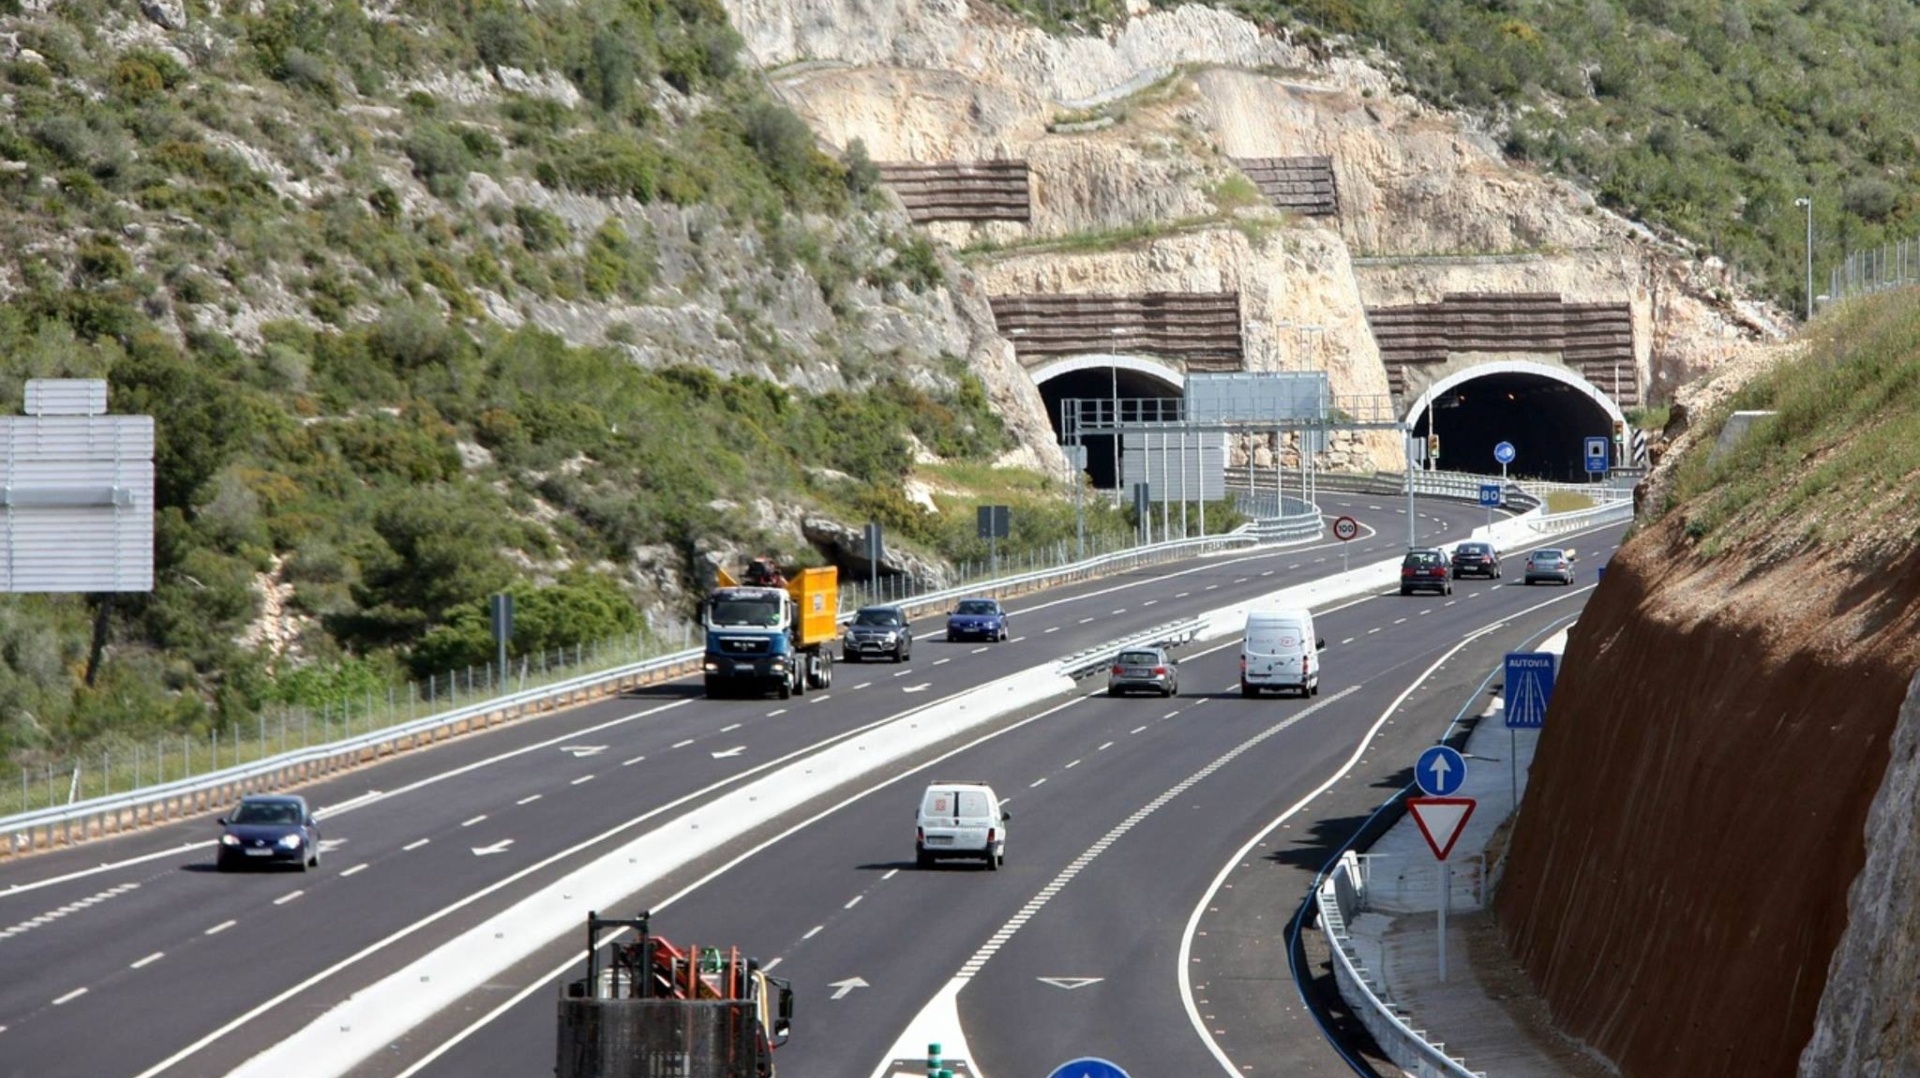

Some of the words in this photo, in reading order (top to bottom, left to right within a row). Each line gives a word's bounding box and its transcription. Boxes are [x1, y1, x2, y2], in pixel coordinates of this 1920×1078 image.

[1481, 490, 1498, 501] 80
[1339, 524, 1354, 532] 100
[1509, 659, 1550, 668] AUTOVIA
